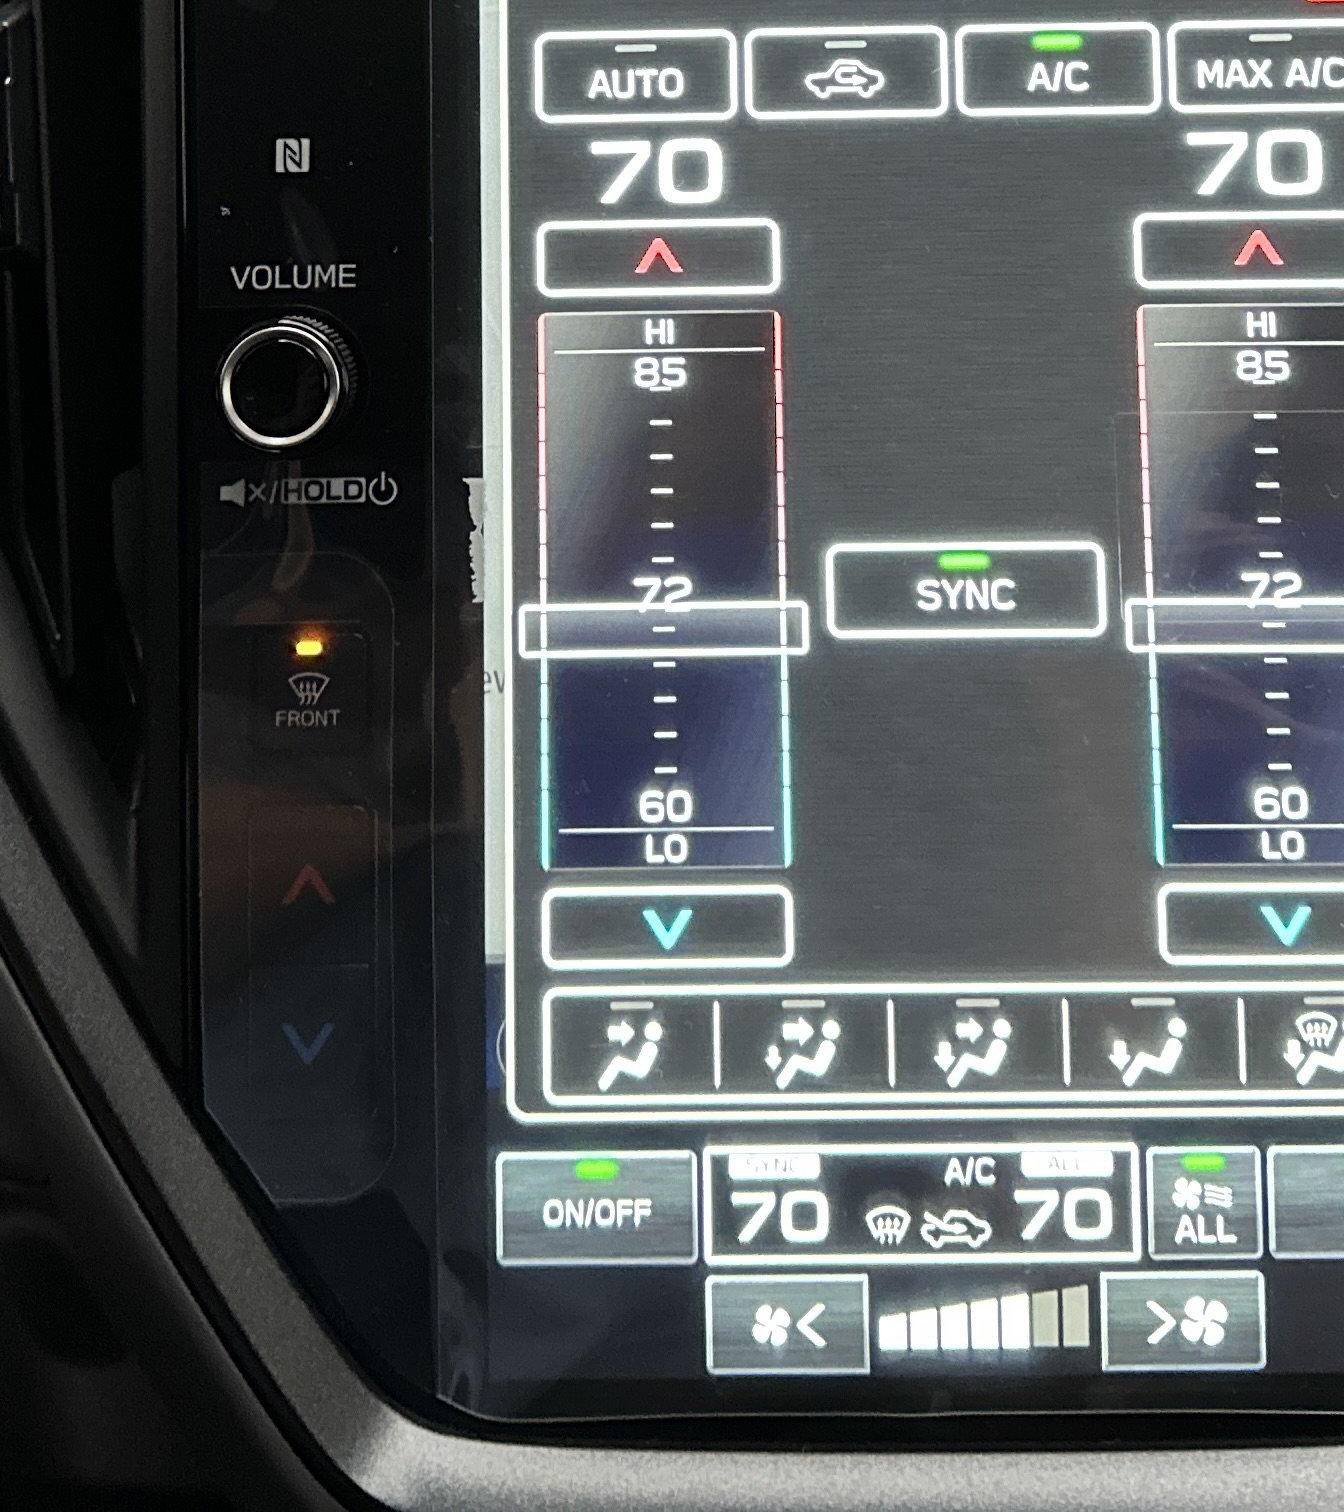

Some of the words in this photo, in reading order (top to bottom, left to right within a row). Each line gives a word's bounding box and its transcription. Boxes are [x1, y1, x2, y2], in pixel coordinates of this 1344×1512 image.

[587, 67, 685, 100] AUTO
[1027, 61, 1090, 93] A/C
[1196, 59, 1273, 90] MAX
[589, 138, 724, 205] 70
[1186, 129, 1324, 196] 70
[230, 264, 357, 290] VOLUME
[644, 318, 676, 346] HI
[1243, 311, 1277, 339] HI
[633, 356, 687, 388] 85
[1235, 349, 1291, 382] 85
[633, 576, 693, 610] 72
[915, 576, 1017, 612] SYNC
[1241, 571, 1302, 608] 72
[275, 708, 339, 728] FRONT
[639, 787, 694, 823] 60
[1253, 784, 1309, 820] 60
[645, 833, 688, 864] LO
[1261, 830, 1305, 863] LO
[944, 1157, 997, 1186] A/C
[542, 1196, 653, 1230] ON/OFF
[731, 1190, 830, 1244] 70
[1013, 1187, 1113, 1241] 70
[1174, 1213, 1238, 1245] ALL
